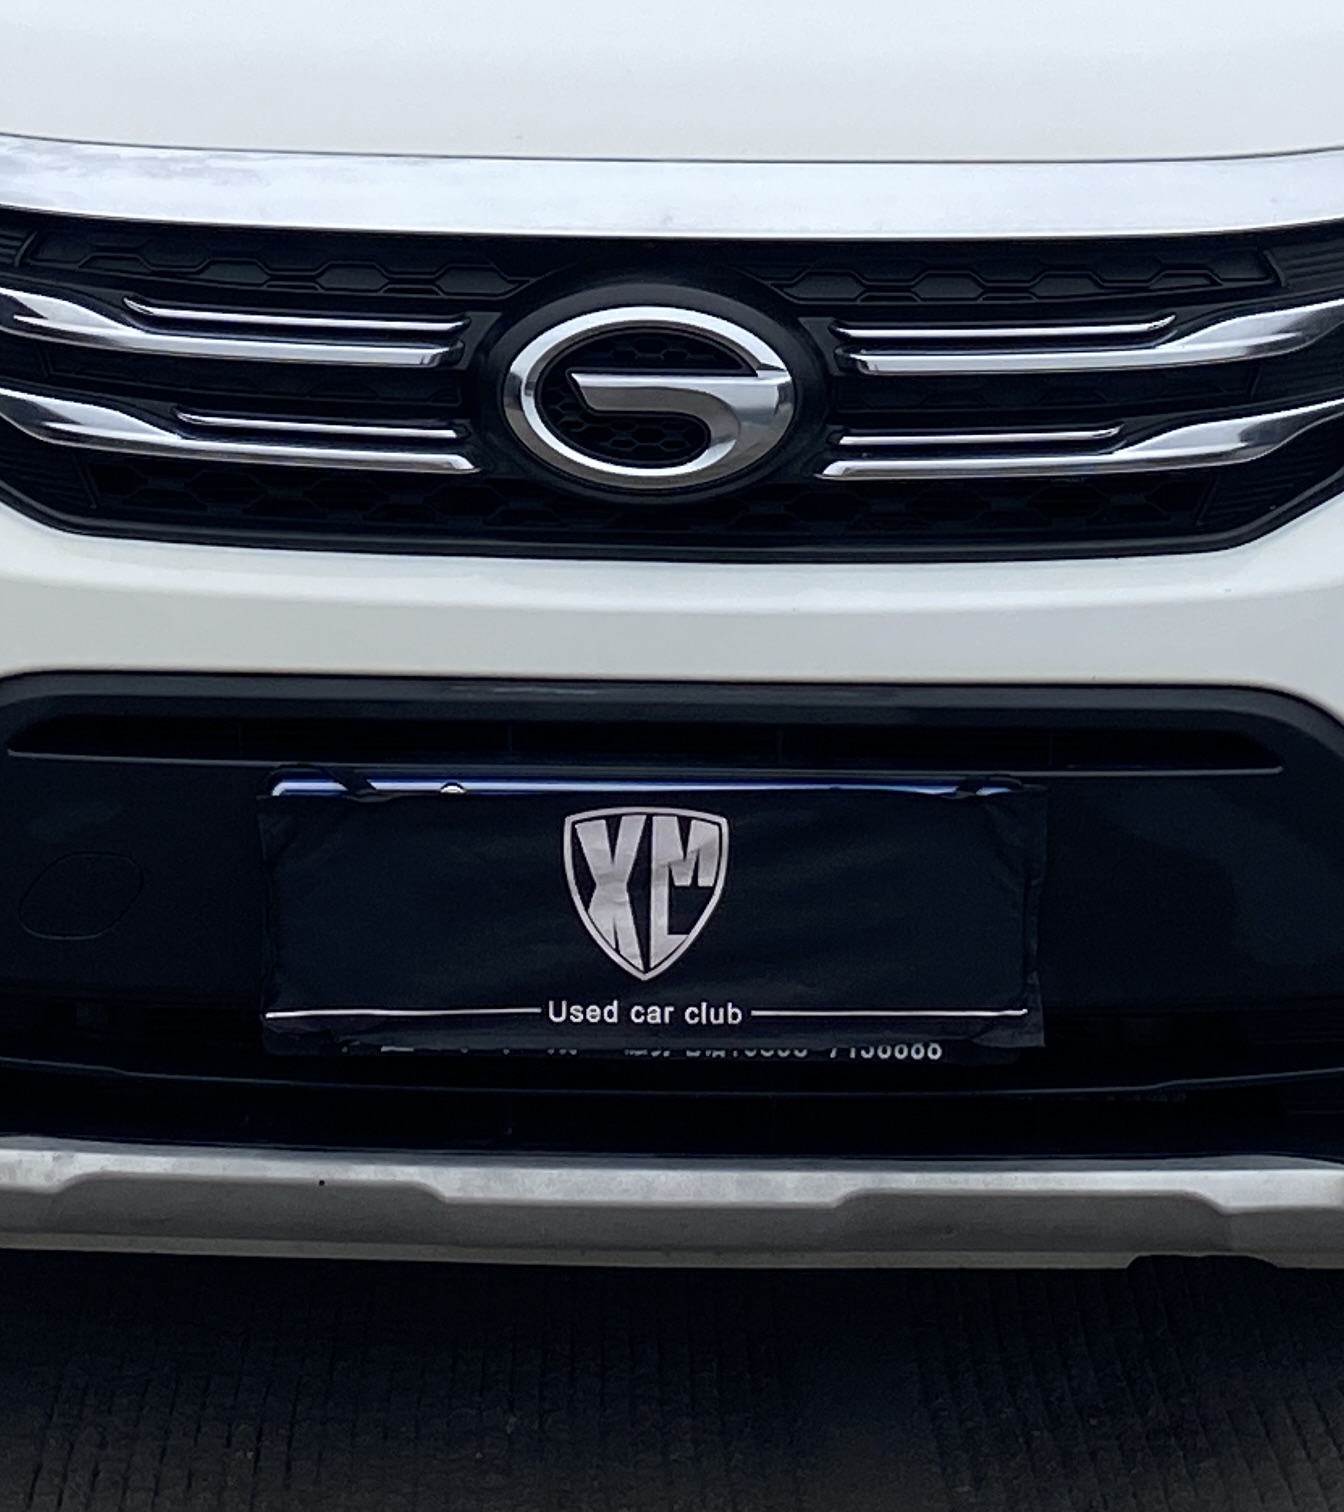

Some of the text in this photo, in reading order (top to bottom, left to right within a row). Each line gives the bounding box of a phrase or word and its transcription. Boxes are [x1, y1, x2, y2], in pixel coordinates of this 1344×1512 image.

[548, 999, 743, 1025] Used car club
